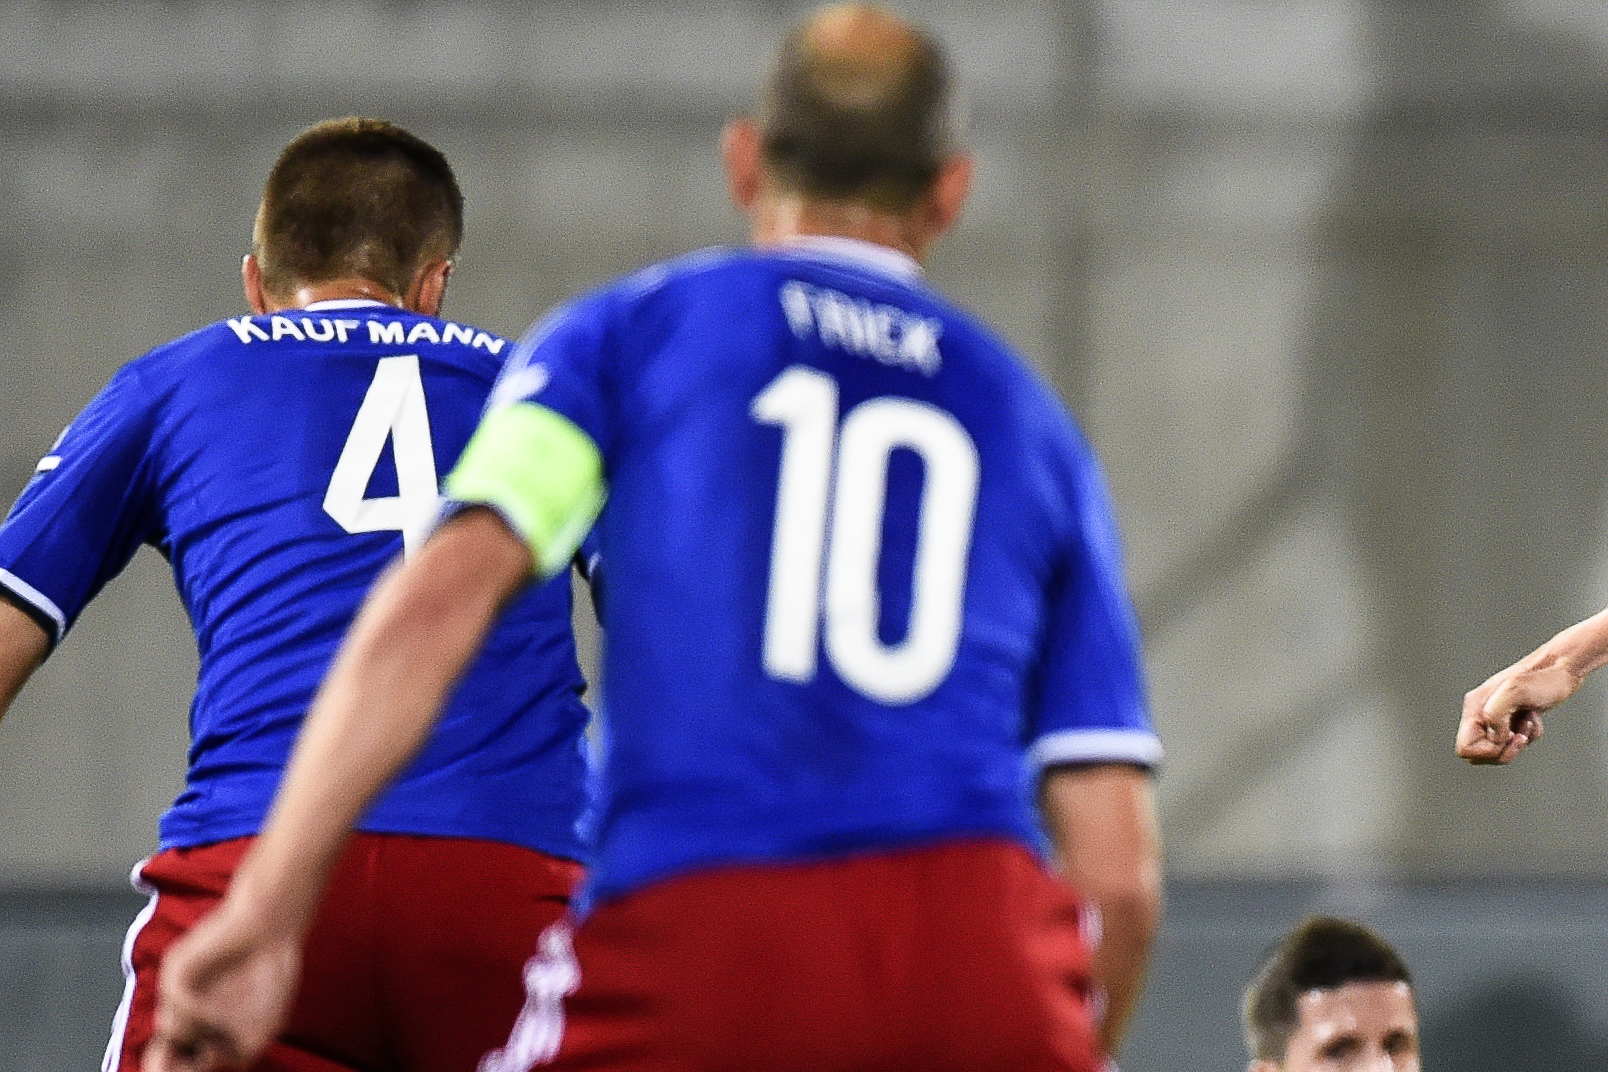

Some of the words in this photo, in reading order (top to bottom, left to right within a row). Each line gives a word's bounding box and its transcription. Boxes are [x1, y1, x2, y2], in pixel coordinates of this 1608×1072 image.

[227, 315, 505, 354] KAUFMANN
[778, 280, 943, 377] FRICK
[323, 354, 440, 564] 4
[750, 364, 981, 706] 10
